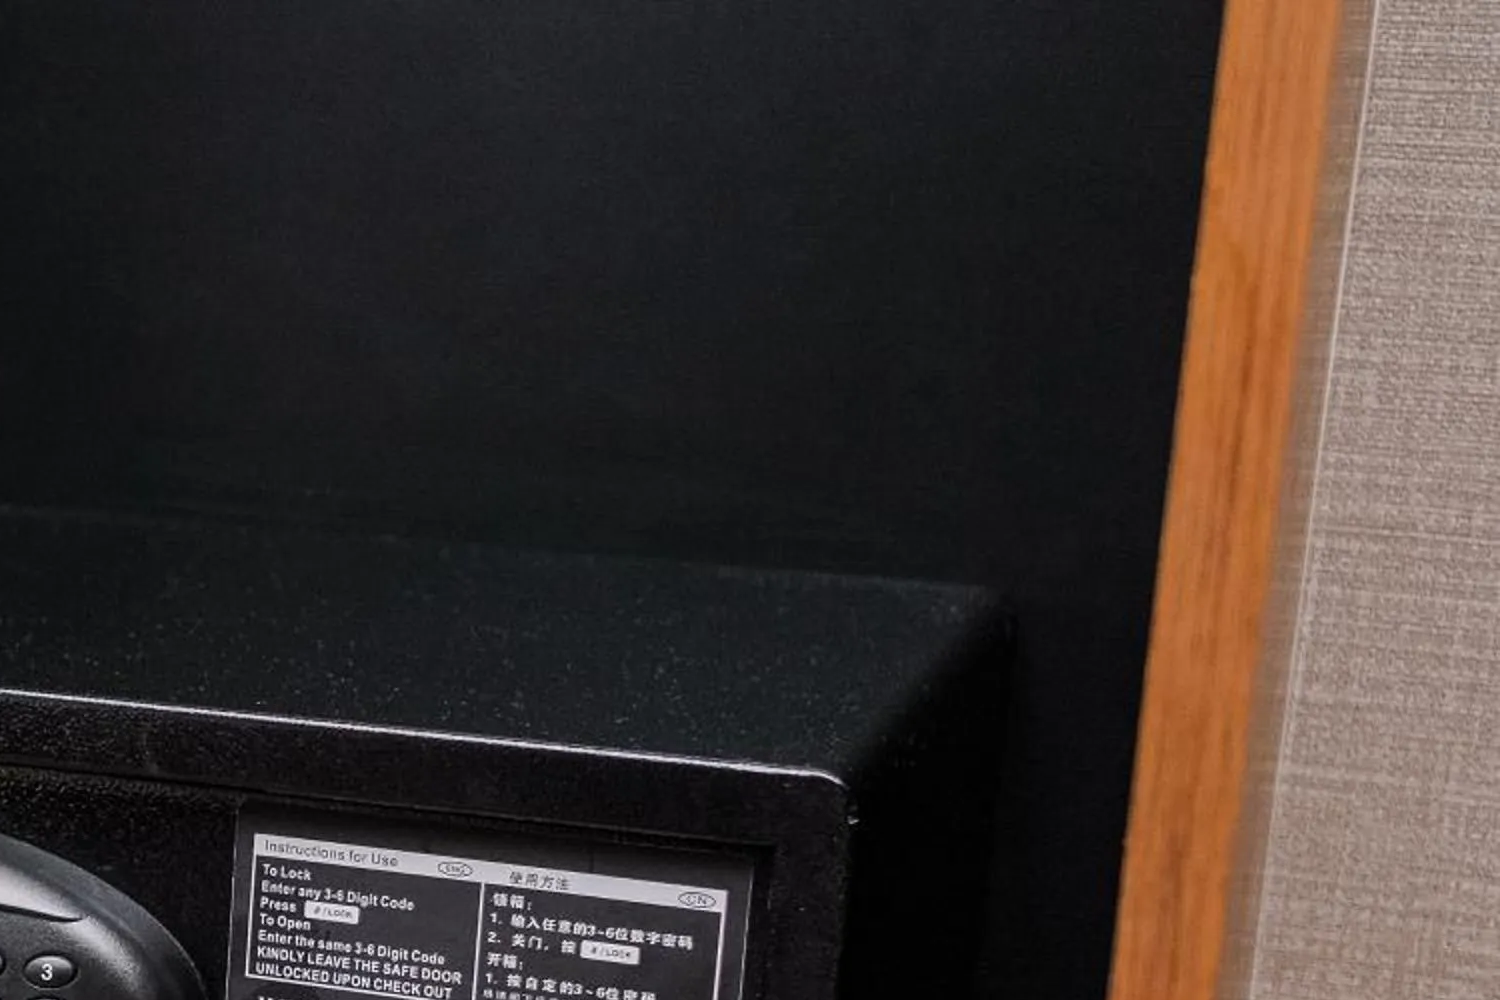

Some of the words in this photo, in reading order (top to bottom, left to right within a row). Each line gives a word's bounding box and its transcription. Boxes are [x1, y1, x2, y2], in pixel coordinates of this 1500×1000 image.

[265, 841, 345, 860] Instructions
[348, 851, 366, 863] for
[371, 853, 399, 867] Use
[262, 864, 277, 877] To
[280, 866, 311, 881] Lock
[509, 871, 572, 891] 使用方法
[260, 897, 296, 913] Press
[261, 881, 294, 896] Enter
[298, 889, 320, 901] any
[324, 888, 344, 902] 3-6
[347, 891, 378, 908] Digit
[380, 895, 415, 911] Code
[259, 914, 274, 925] To
[277, 916, 310, 932] Open
[489, 913, 503, 925] 1.
[258, 930, 292, 945] Enter
[295, 935, 314, 948] the
[317, 941, 351, 953] same
[355, 942, 375, 956] 3-6
[377, 945, 408, 963] Digit
[411, 950, 445, 965] Code
[488, 931, 501, 943] 2.
[560, 939, 576, 955] 按
[42, 965, 52, 980] 3
[257, 946, 304, 963] KINDLY
[307, 953, 350, 970] LEAVE
[353, 959, 378, 973] THE
[383, 963, 418, 979] SAFE
[421, 968, 462, 984] DOOR
[256, 962, 330, 983] UNLOCKED
[333, 972, 369, 988] UPON
[373, 978, 420, 995] CHECK
[423, 985, 452, 999] OUT
[485, 972, 499, 984] 1.
